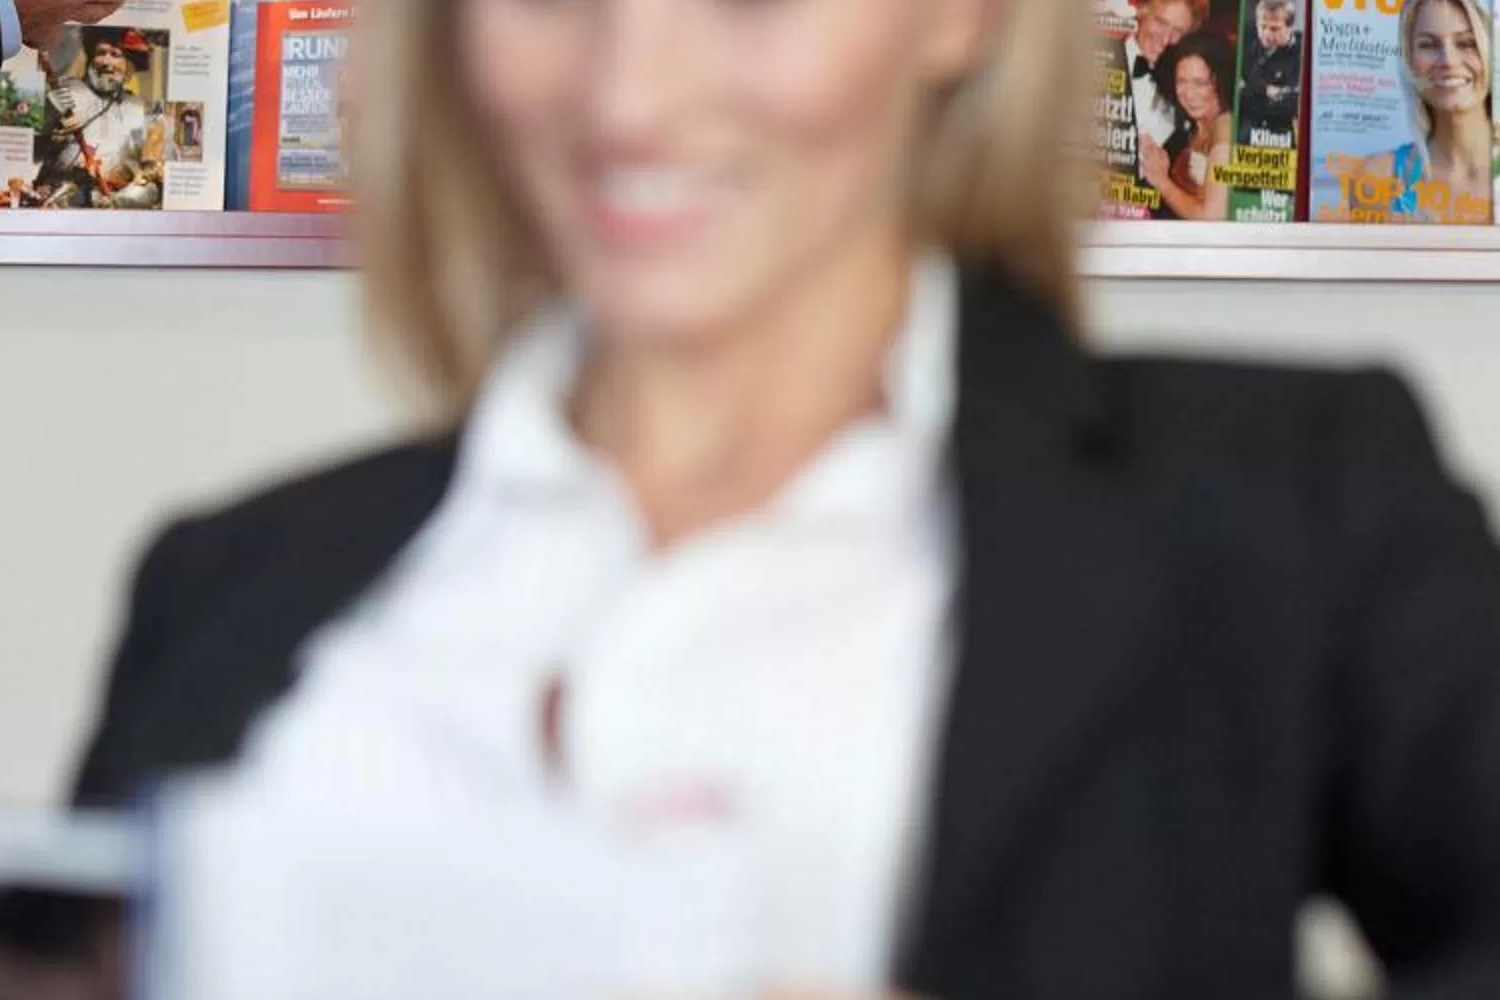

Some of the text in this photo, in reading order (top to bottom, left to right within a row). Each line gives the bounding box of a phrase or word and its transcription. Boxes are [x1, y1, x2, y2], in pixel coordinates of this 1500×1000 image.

[1250, 128, 1291, 147] Klinsi
[1236, 148, 1290, 168] Verjagt!
[1212, 167, 1289, 187] Verspottet!
[1337, 173, 1404, 206] TOP
[1414, 179, 1451, 212] 10
